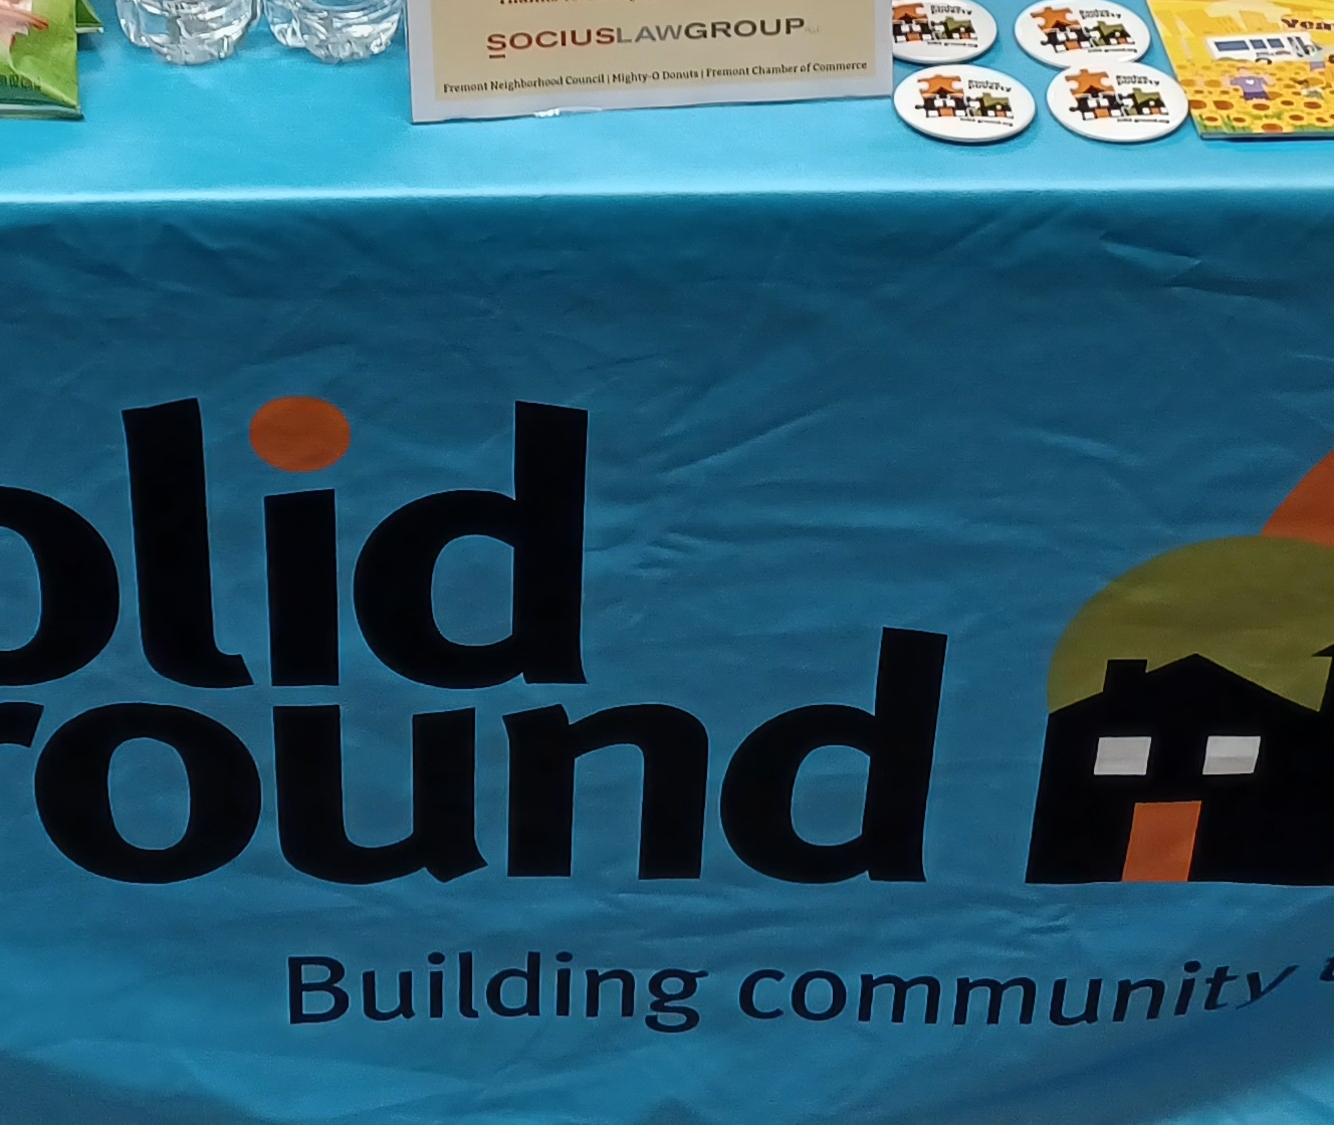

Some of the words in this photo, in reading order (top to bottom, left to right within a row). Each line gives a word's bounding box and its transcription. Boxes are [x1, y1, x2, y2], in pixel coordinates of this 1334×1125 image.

[444, 82, 488, 93] Fremont
[491, 76, 564, 92] Neighborhood
[565, 74, 605, 85] Council
[613, 71, 660, 84] Mighty-O
[663, 70, 698, 80] Donuts
[706, 68, 749, 77] Fremont
[752, 64, 798, 75] Chamber
[801, 62, 811, 72] of
[813, 61, 867, 72] Commerce
[288, 949, 704, 1033] Building
[737, 958, 1299, 1029] community
